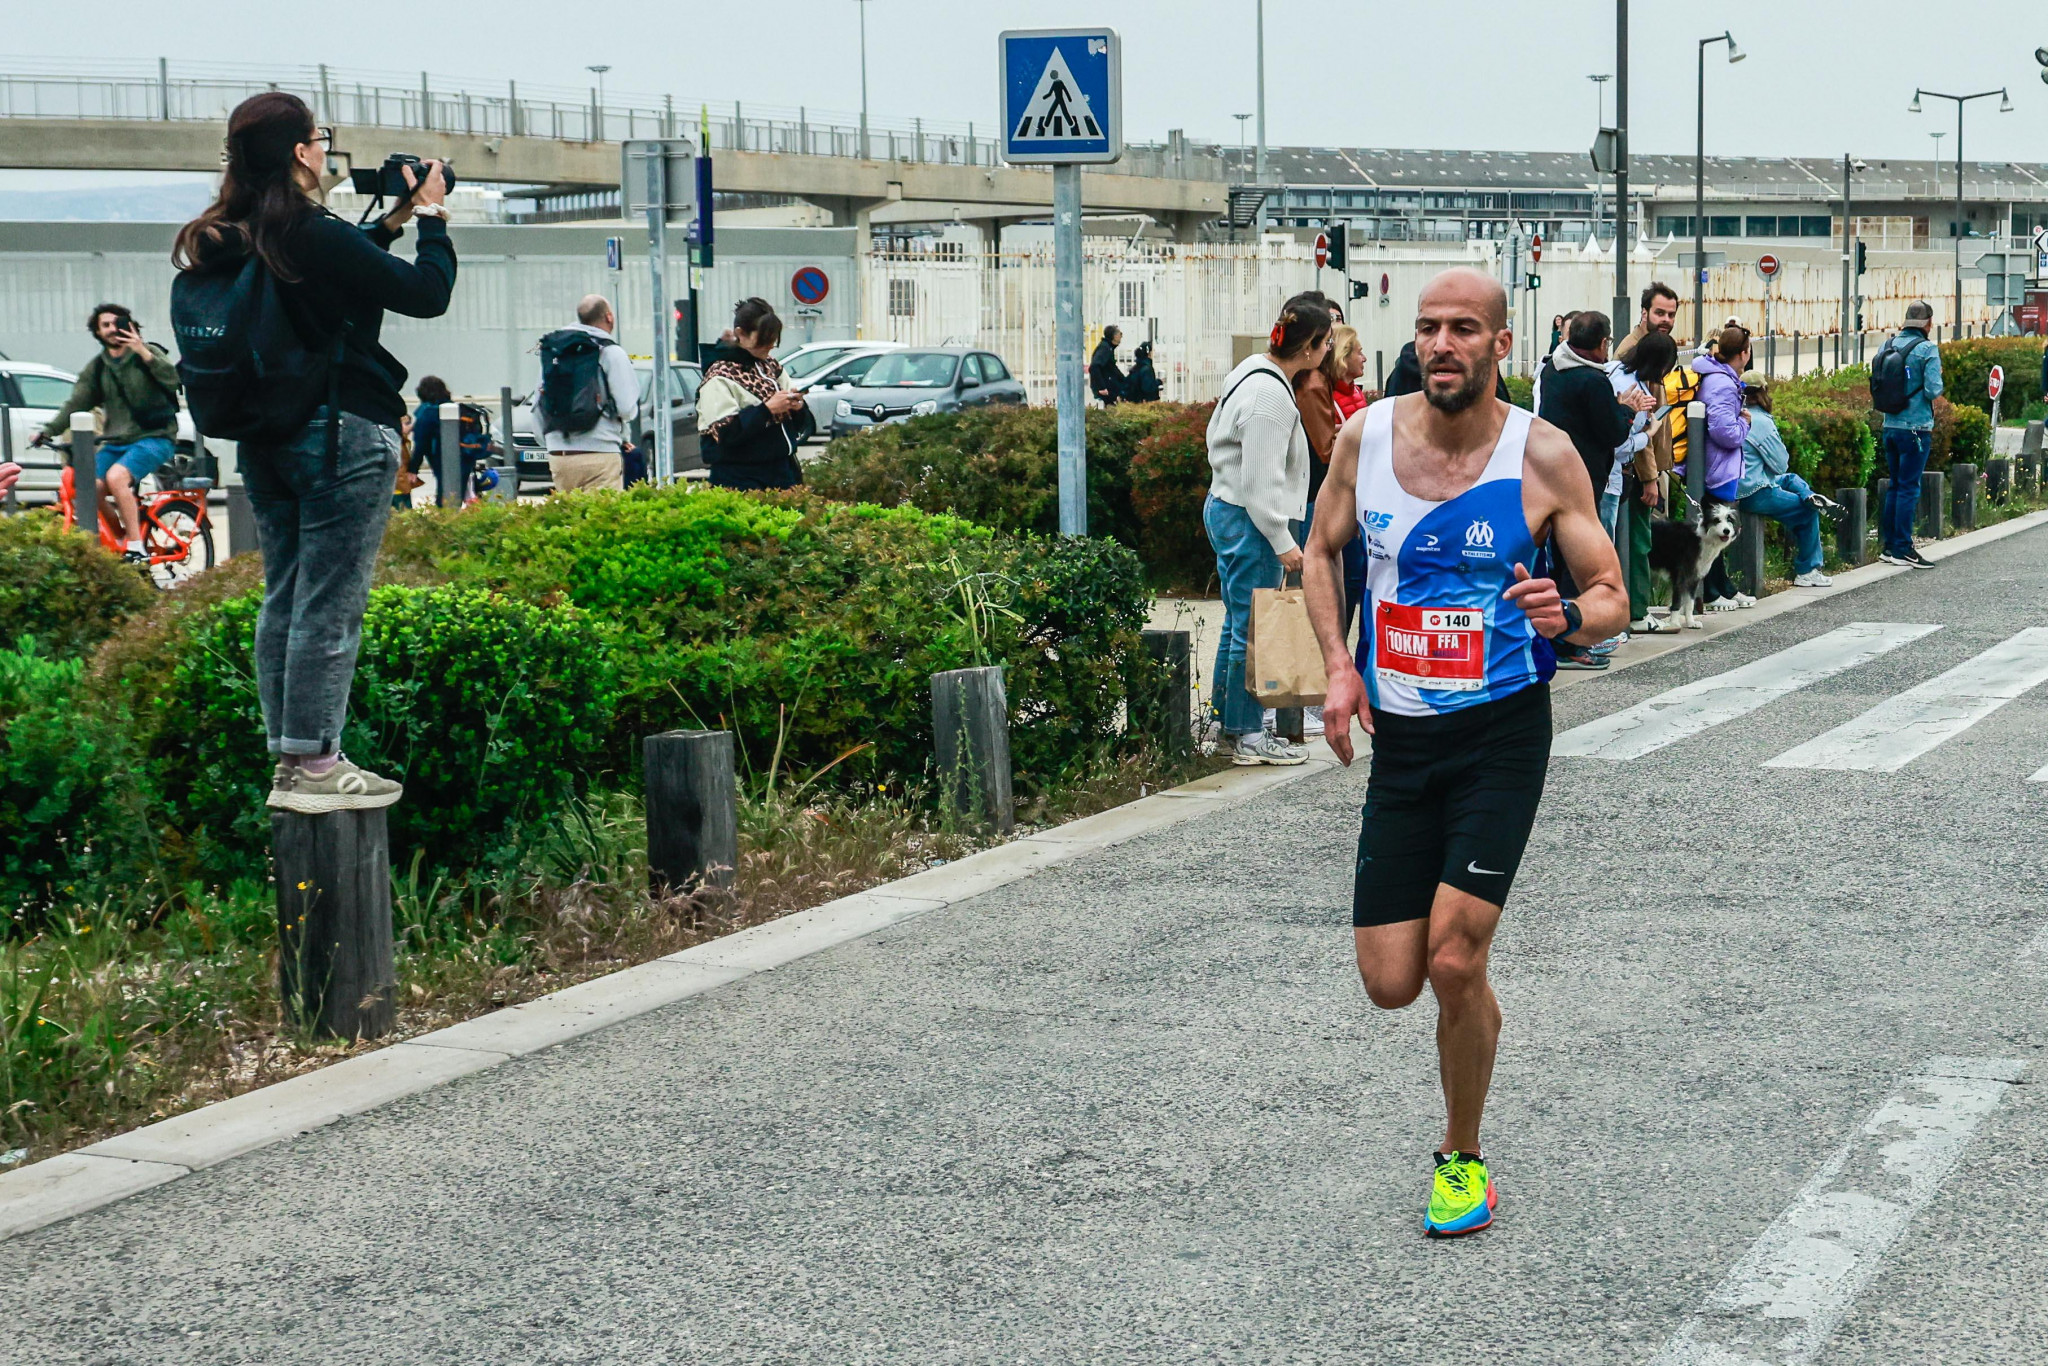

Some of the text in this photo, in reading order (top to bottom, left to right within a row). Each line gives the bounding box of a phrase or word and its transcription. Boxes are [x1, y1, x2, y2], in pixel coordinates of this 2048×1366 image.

[1445, 615, 1470, 627] 140
[1388, 630, 1459, 657] 10KM FFA
